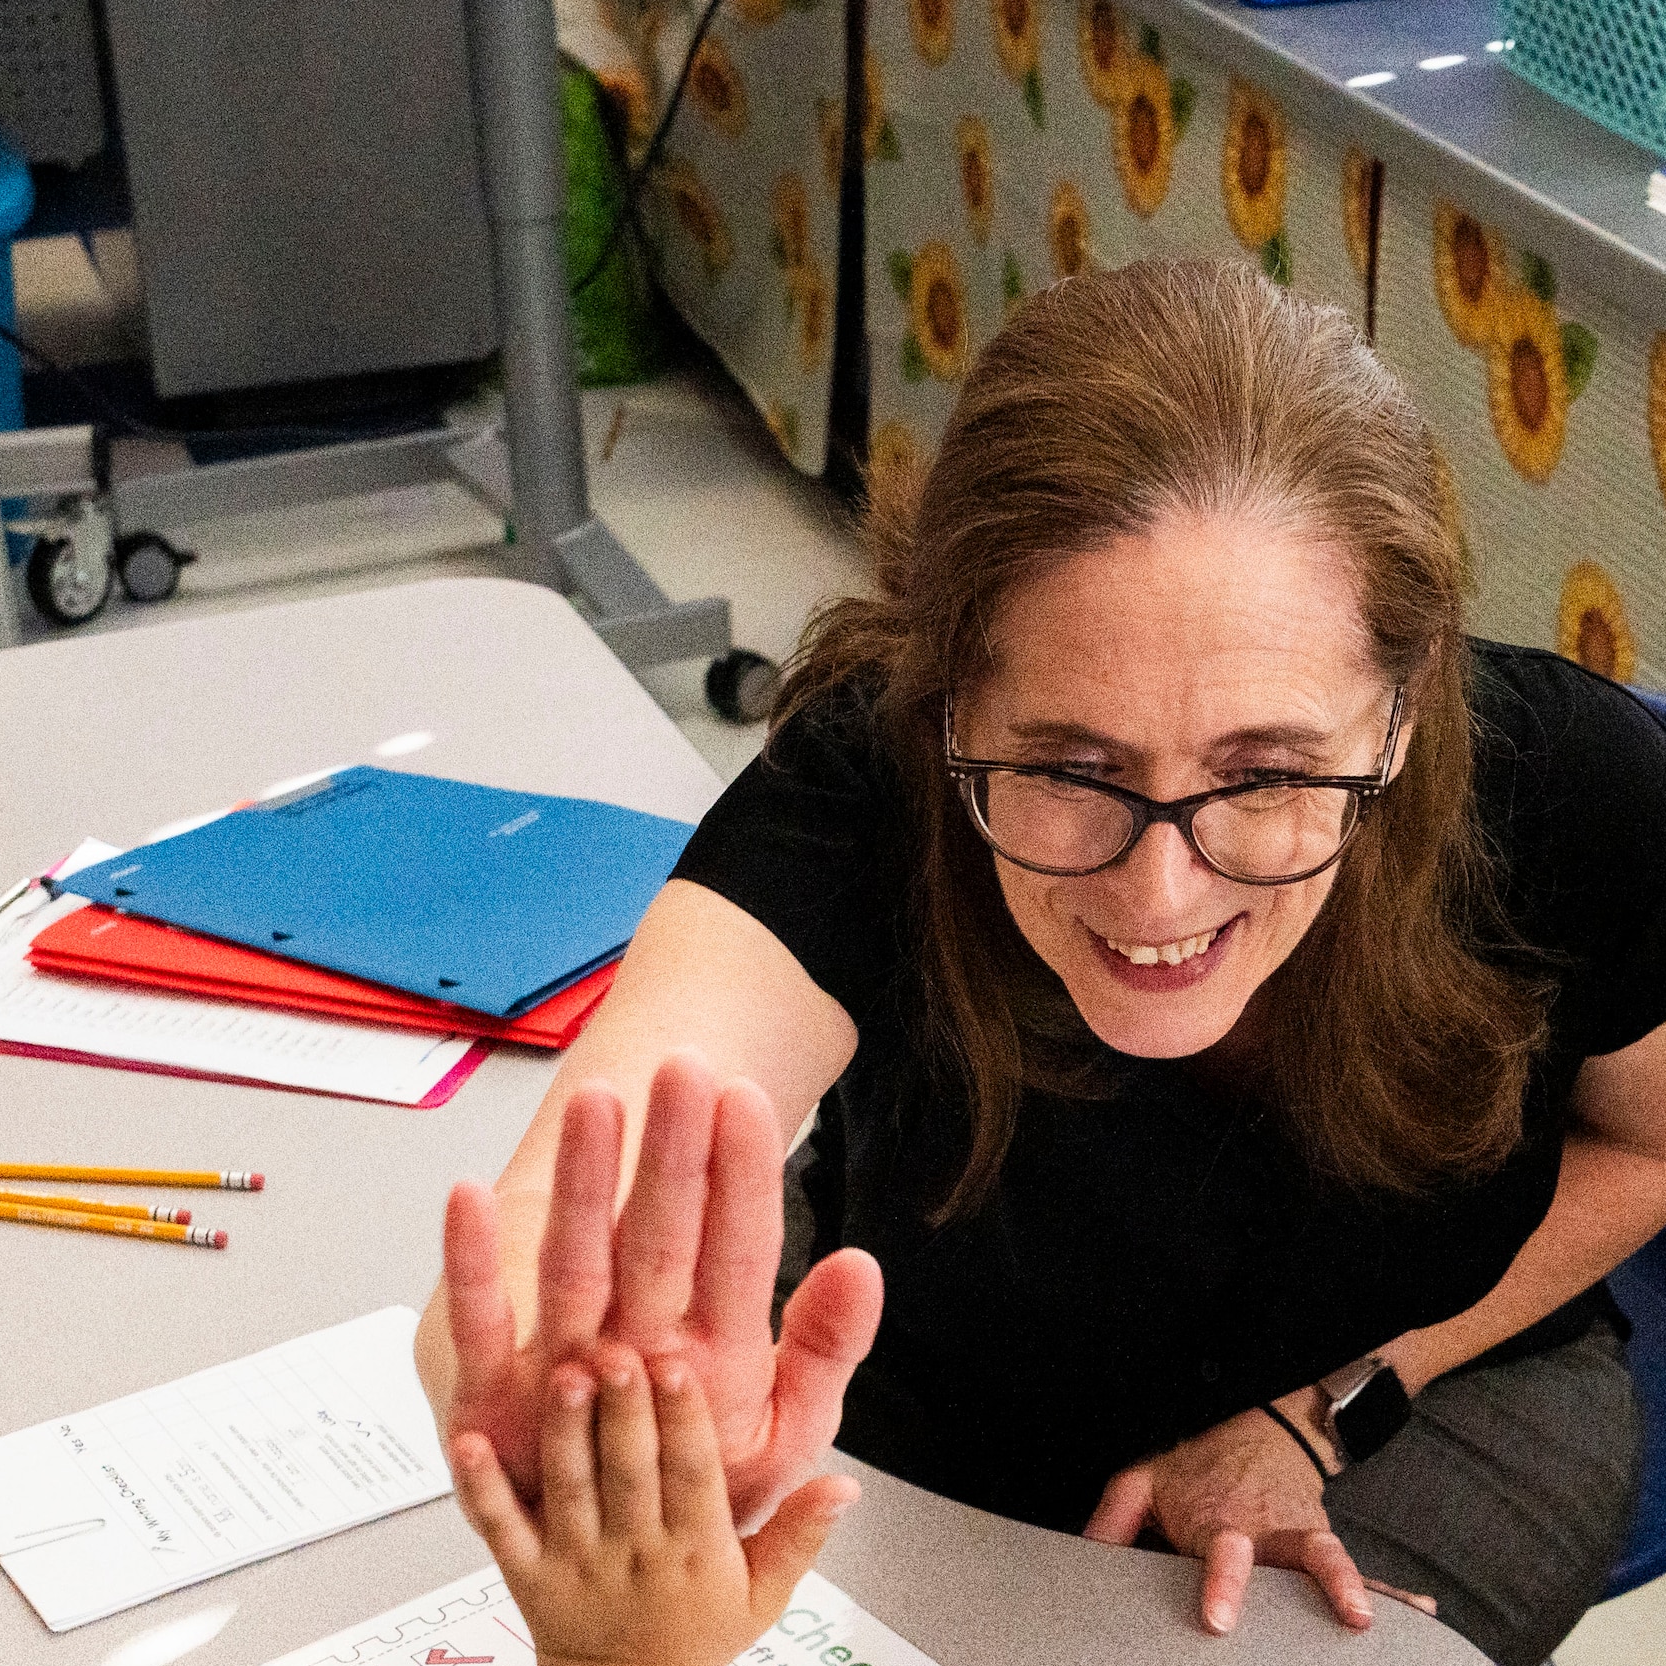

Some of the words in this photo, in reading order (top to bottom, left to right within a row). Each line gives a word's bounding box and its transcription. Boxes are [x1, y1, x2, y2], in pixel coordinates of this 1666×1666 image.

[60, 1424, 72, 1437] No
[71, 1437, 87, 1454] Yes
[101, 1464, 135, 1498] Checklist
[131, 1497, 160, 1530] Writing
[156, 1529, 173, 1543] My
